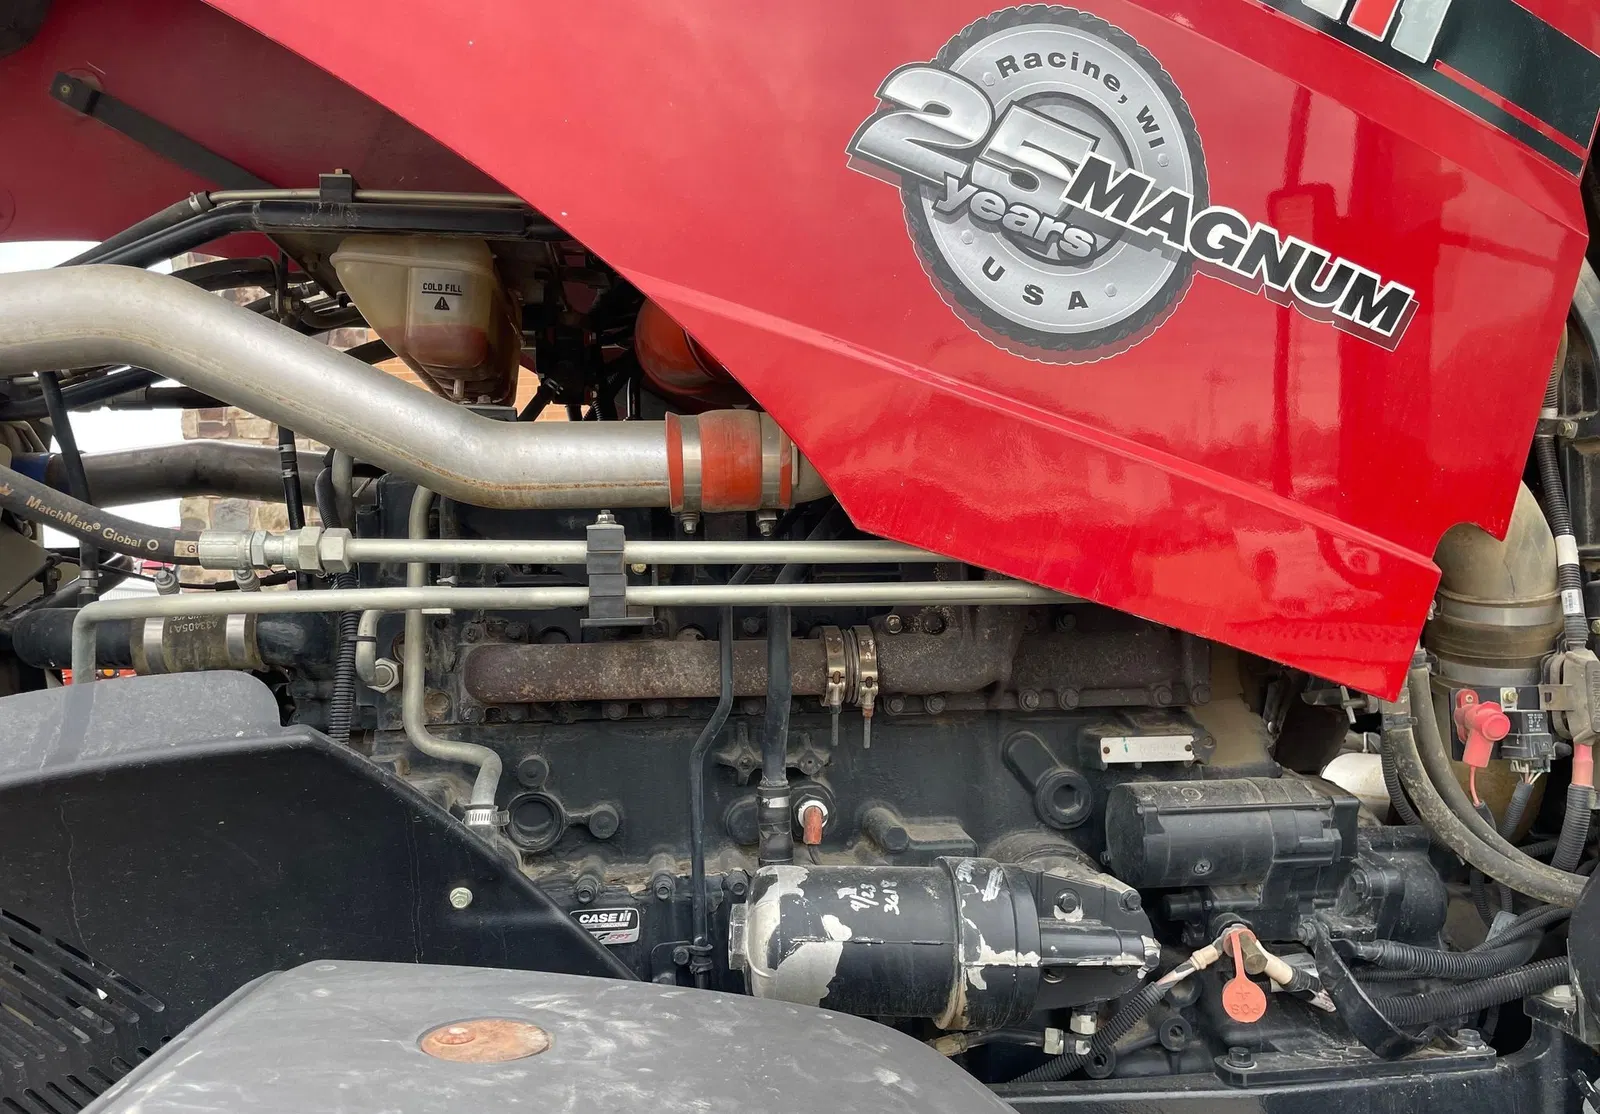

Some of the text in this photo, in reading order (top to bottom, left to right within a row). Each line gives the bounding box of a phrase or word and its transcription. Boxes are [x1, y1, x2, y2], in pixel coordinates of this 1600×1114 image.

[847, 63, 1100, 218] 25
[995, 51, 1166, 149] Racine, WI
[932, 172, 1098, 260] years
[1060, 154, 1415, 337] MAGNUM
[422, 282, 462, 292] COLD FILL
[102, 527, 143, 548] Global
[579, 912, 618, 924] CASE
